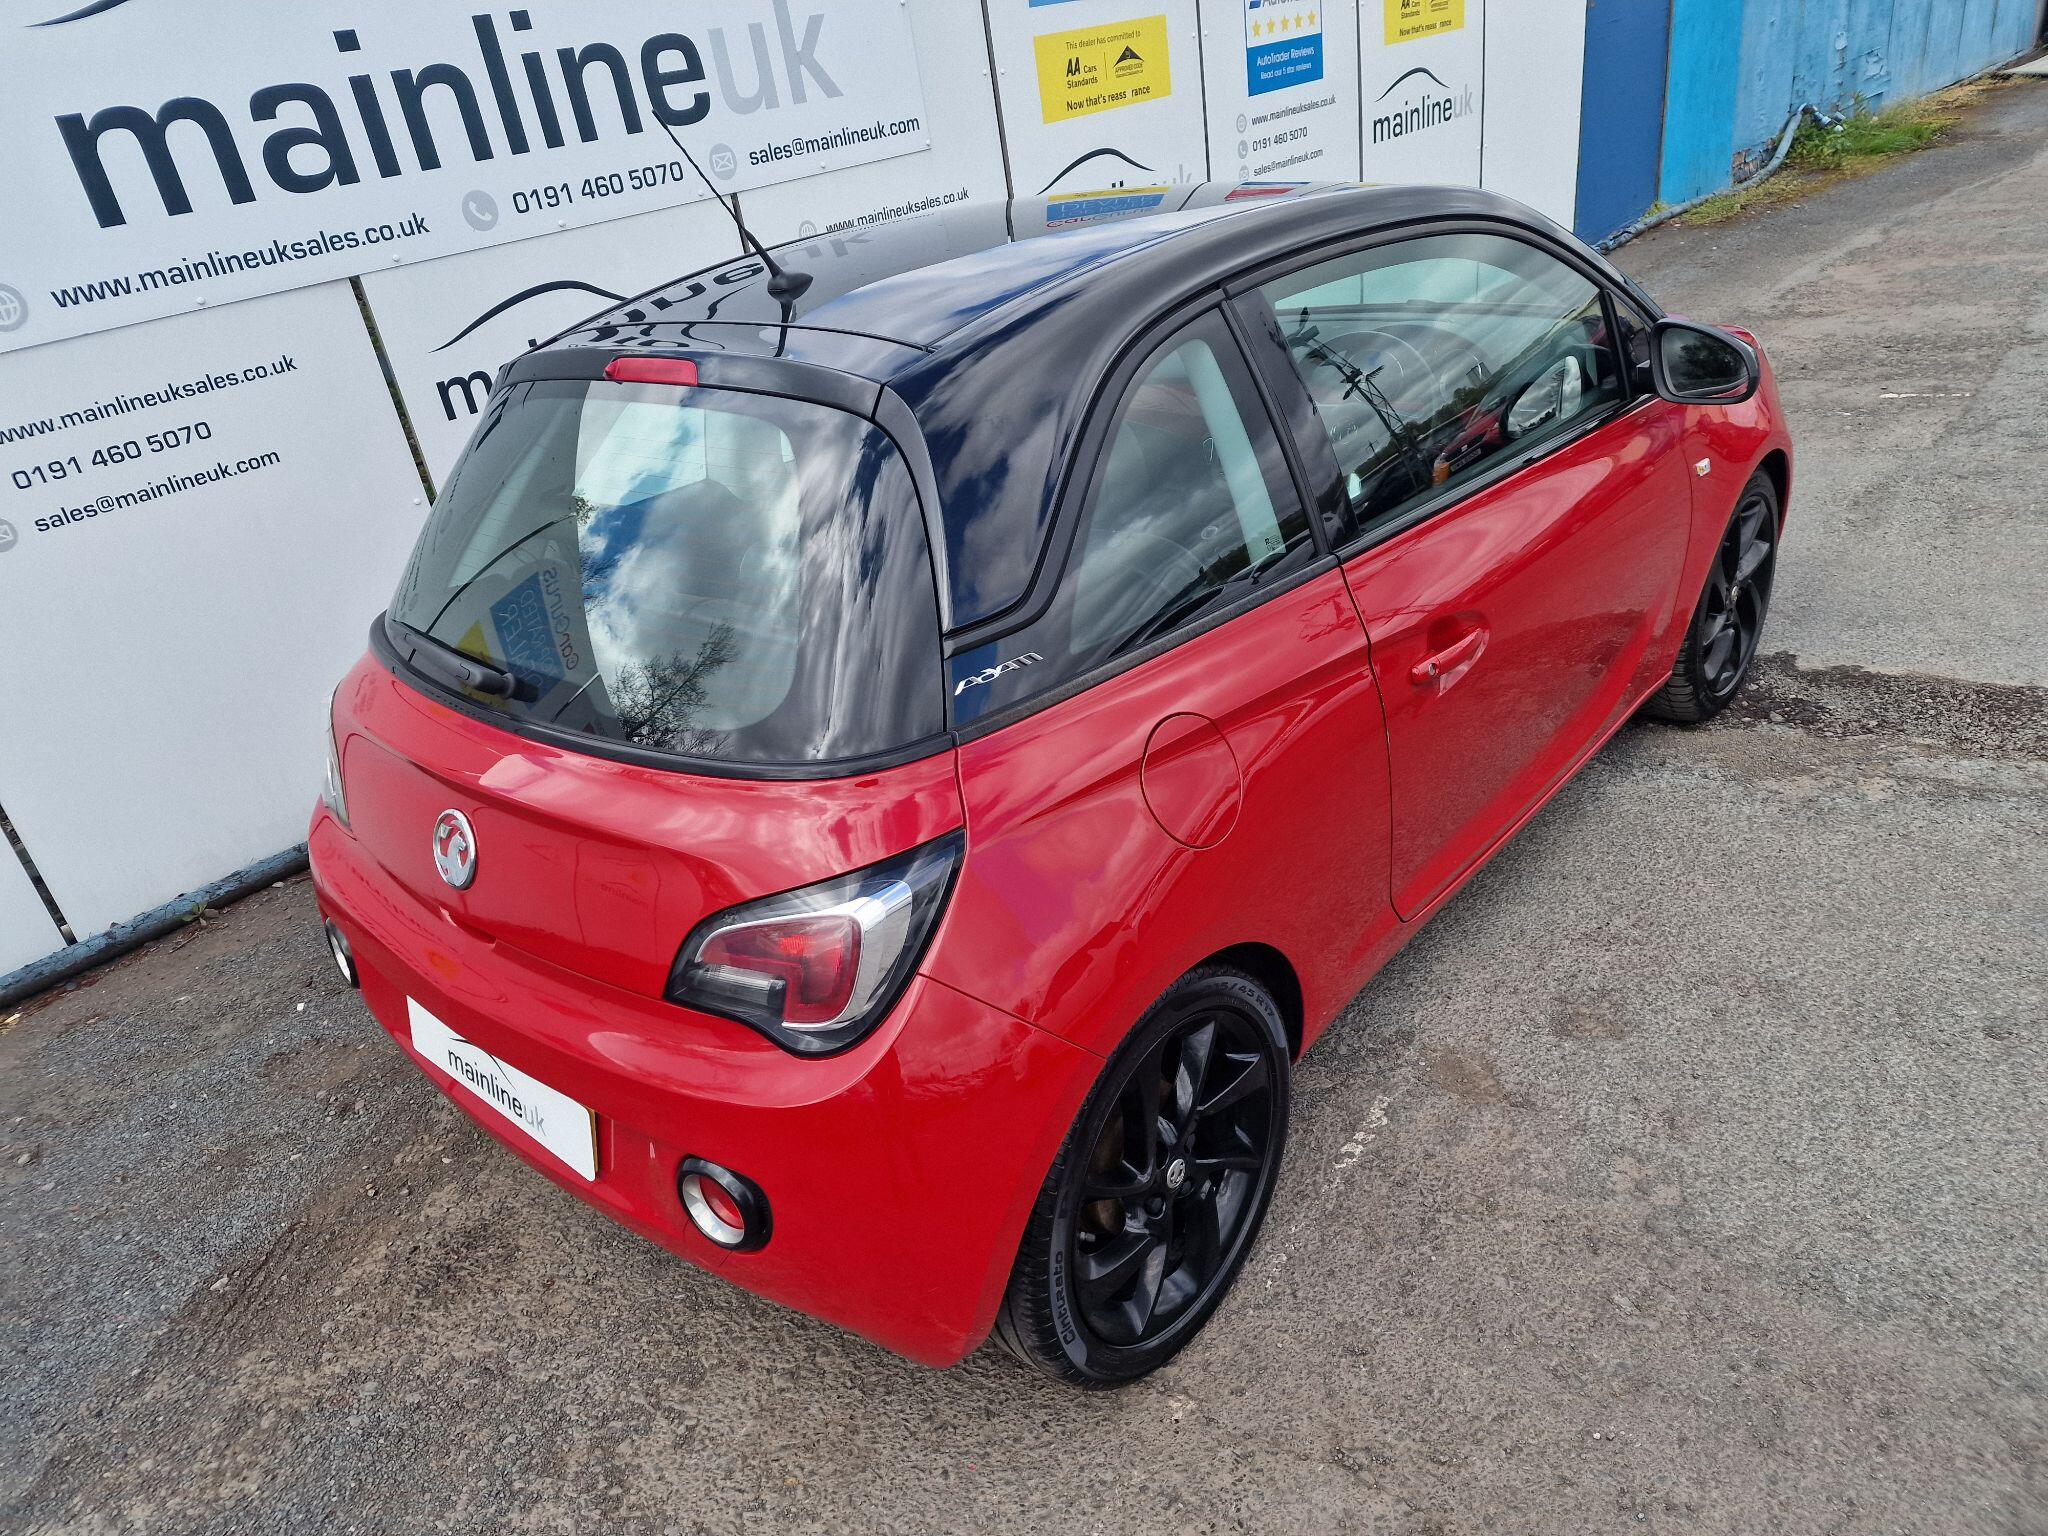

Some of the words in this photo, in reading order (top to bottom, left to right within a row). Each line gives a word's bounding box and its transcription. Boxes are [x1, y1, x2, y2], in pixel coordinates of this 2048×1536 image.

[1066, 41, 1078, 50] This
[1078, 37, 1096, 49] dealer
[1096, 36, 1107, 45] has
[1106, 30, 1135, 43] committed
[1135, 29, 1141, 39] to
[1399, 27, 1411, 37] Now
[1411, 23, 1425, 34] that's
[1066, 57, 1081, 77] AA
[1083, 64, 1098, 74] Cars
[1257, 50, 1290, 66] AutoTrader
[1290, 46, 1315, 59] Reviews
[1260, 69, 1274, 80] Read
[1066, 100, 1085, 112] Now
[1085, 93, 1107, 107] that's
[1107, 85, 1151, 102] reassrance
[1067, 75, 1099, 89] Standards
[54, 0, 844, 228] mainlineuk
[1251, 94, 1337, 126] www.mainlineuksales.co.uk
[1373, 83, 1473, 144] mainlineuk
[748, 115, 921, 167] sales@mainlineuk.com
[1252, 134, 1272, 152] 0191
[1289, 126, 1308, 142] 5070
[1253, 148, 1324, 177] sales@mainlineuk.com
[512, 183, 574, 214] 0191
[580, 172, 625, 201] 460
[630, 161, 685, 191] 5070
[826, 187, 971, 233] www.mainlineuksales.co.uk
[50, 213, 431, 309] www.mainlineuksales.co.uk
[0, 354, 298, 445] www.mainlineuksales.co.uk
[11, 456, 83, 490] 0191
[91, 440, 143, 468] 460
[145, 421, 212, 453] 5070
[34, 450, 281, 532] sales@mainlineuk.com
[447, 1048, 548, 1138] mainlineuk
